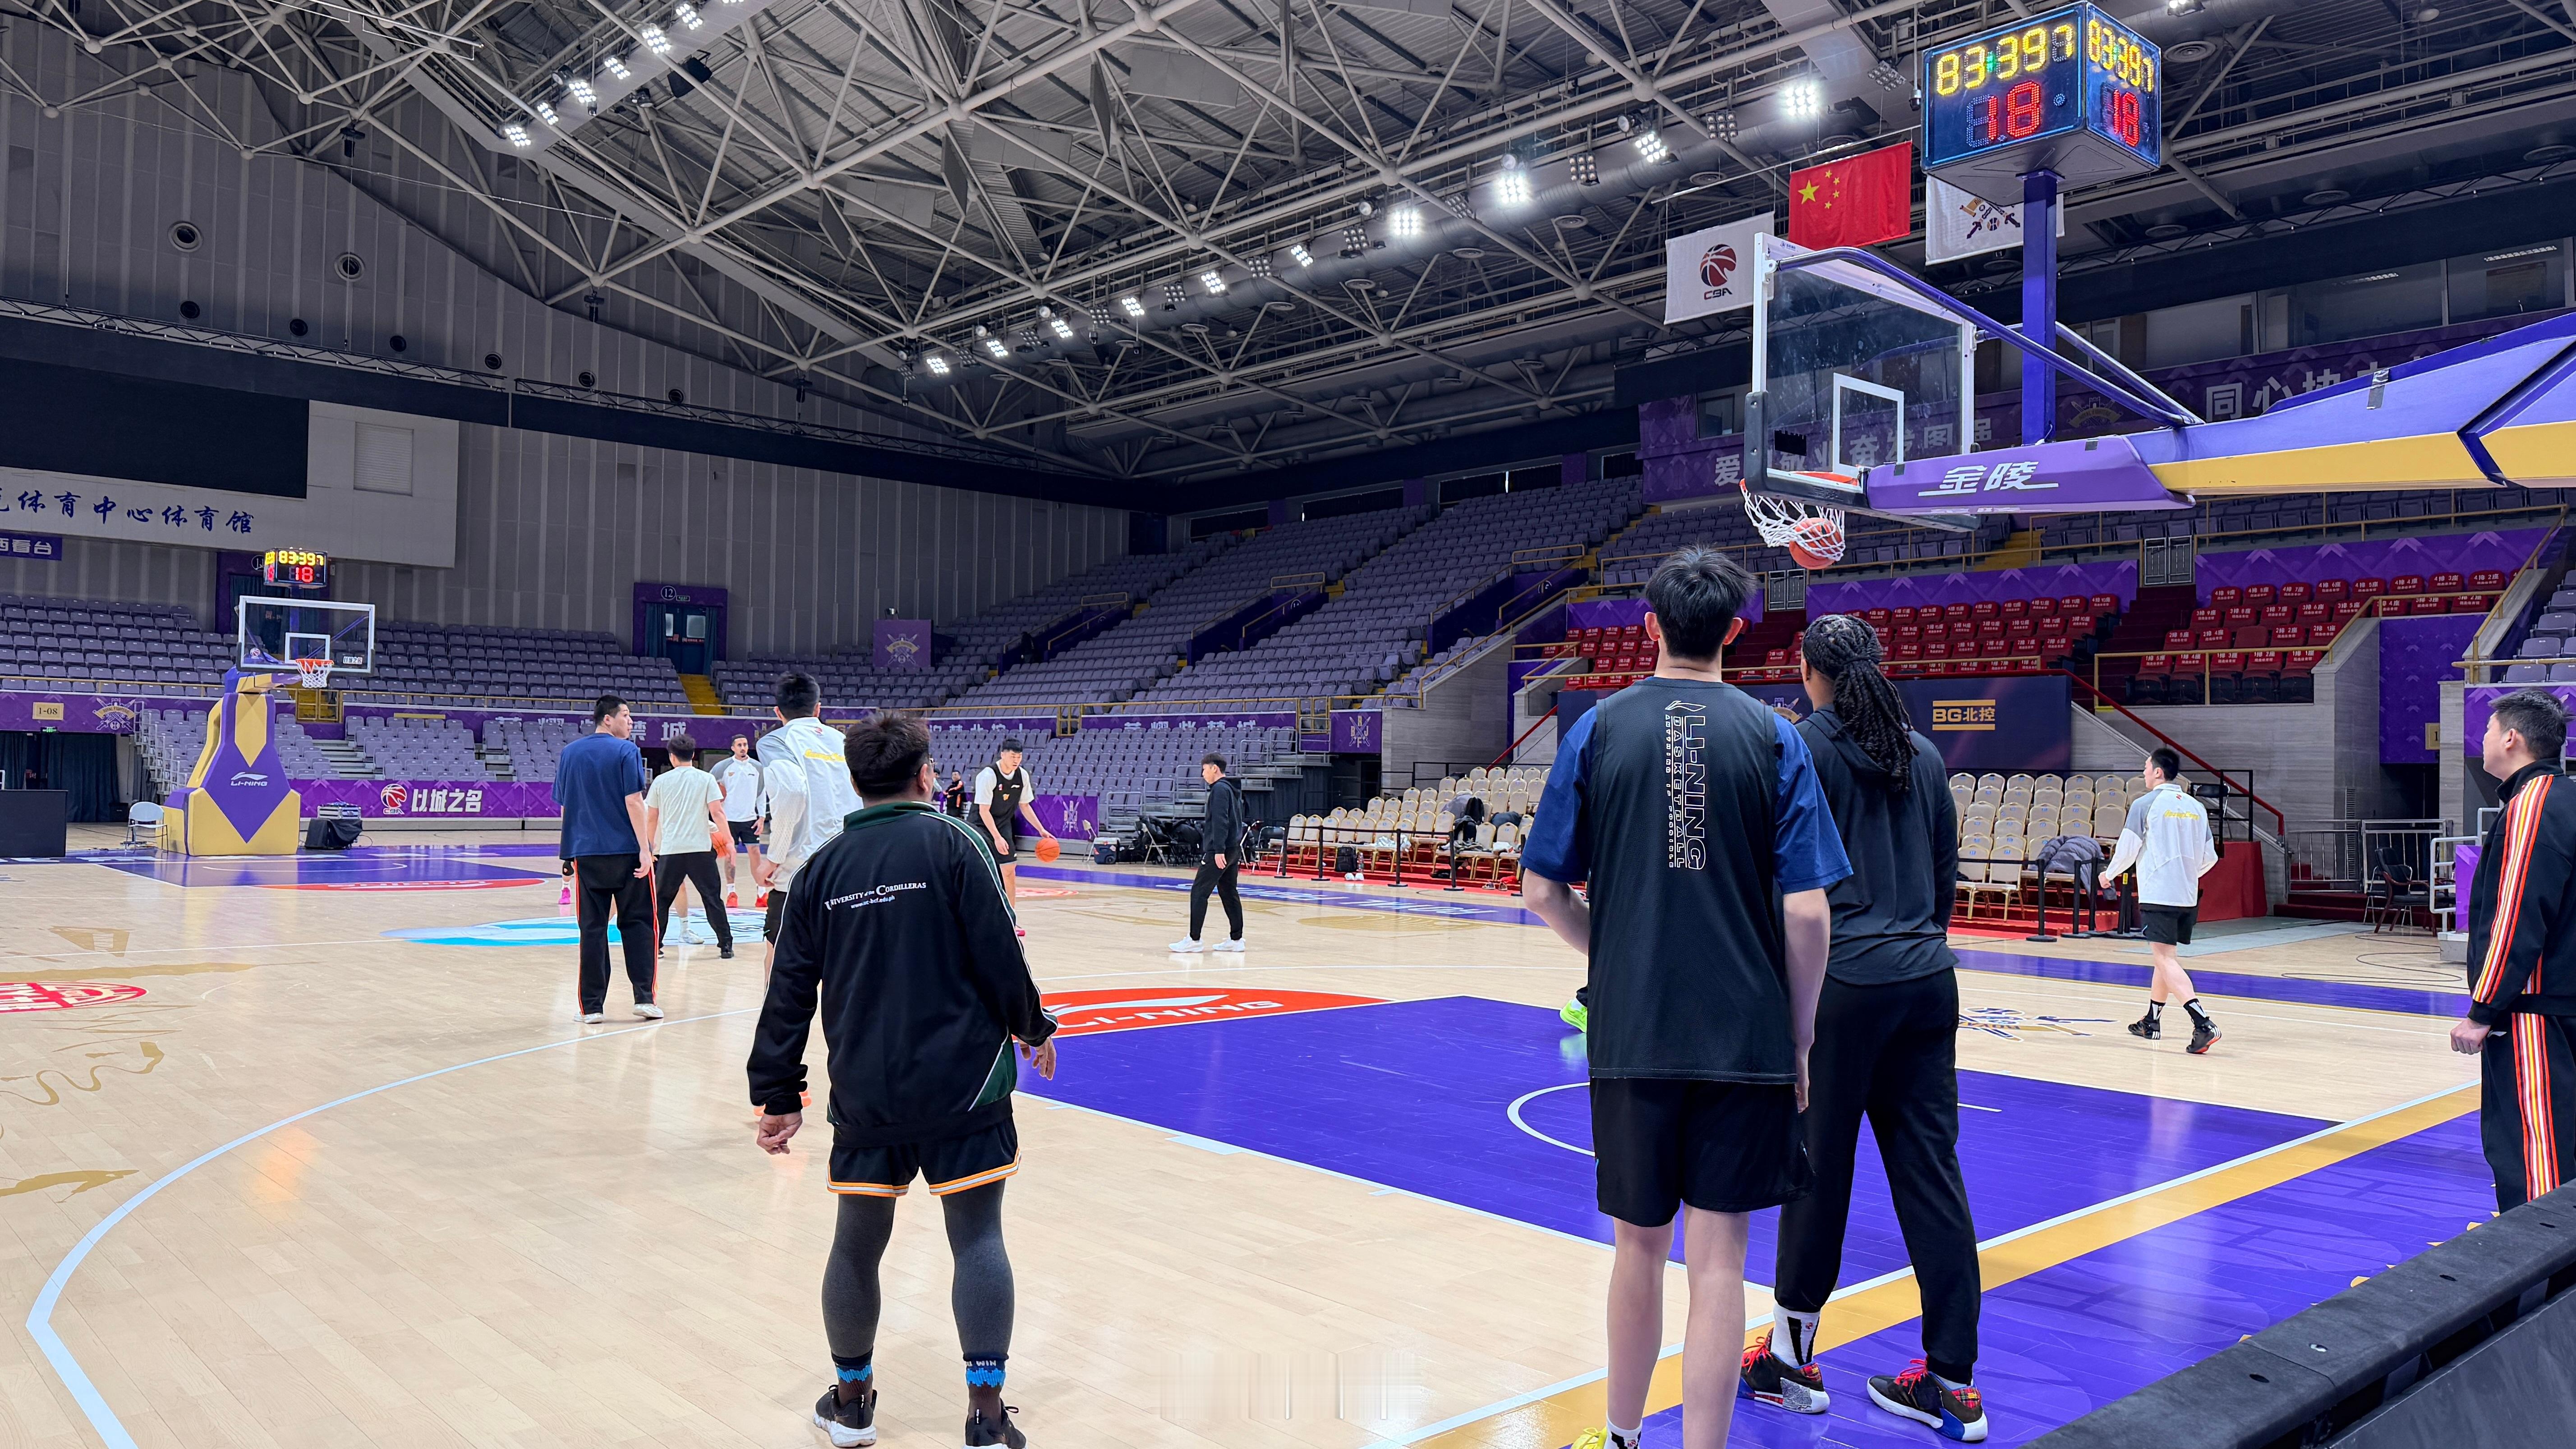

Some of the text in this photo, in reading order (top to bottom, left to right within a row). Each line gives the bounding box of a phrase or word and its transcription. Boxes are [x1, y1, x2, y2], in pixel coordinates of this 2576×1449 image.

[1988, 80, 2041, 140] 18
[2113, 89, 2139, 147] 18
[1704, 288, 1733, 300] CBA
[1918, 461, 2058, 497] 金陵
[665, 588, 673, 598] 12
[1932, 707, 1995, 722] BG北控
[411, 788, 482, 813] 以城之名
[1673, 716, 1685, 868] BASKETBALL
[1684, 715, 1706, 870] LI-NING
[876, 882, 926, 896] CORDILLERAS
[1058, 1000, 1284, 1029] LI-NING
